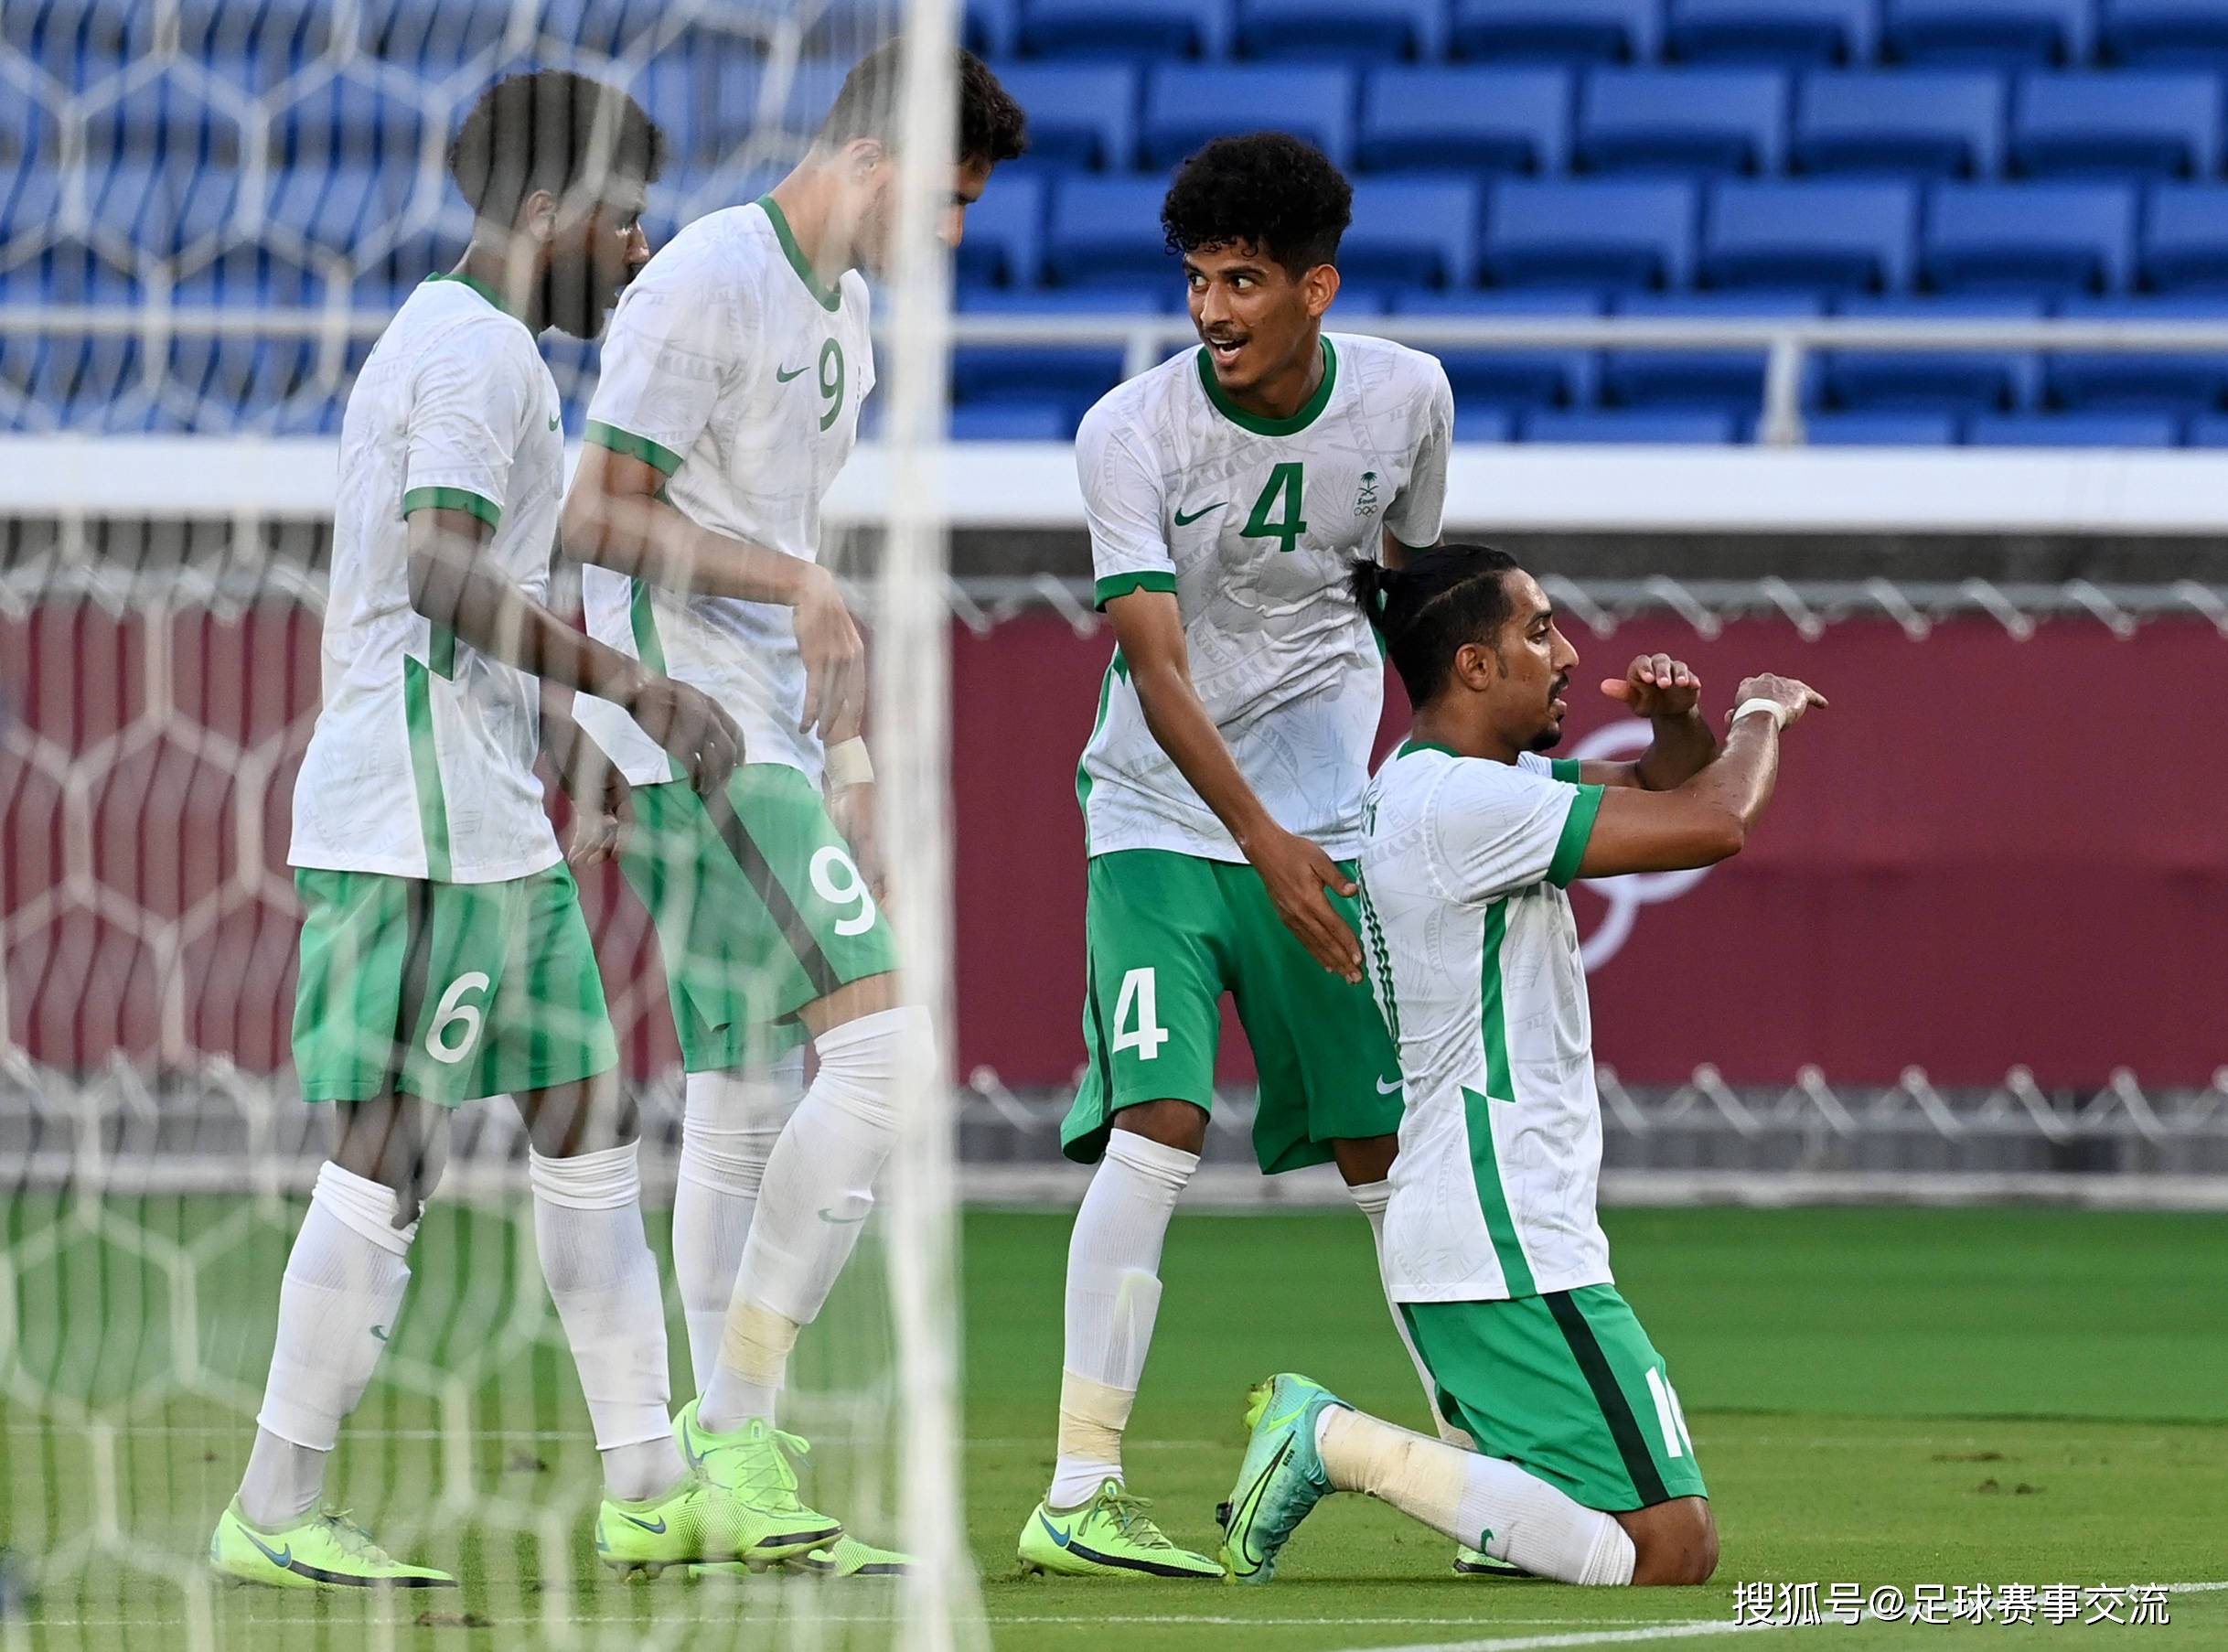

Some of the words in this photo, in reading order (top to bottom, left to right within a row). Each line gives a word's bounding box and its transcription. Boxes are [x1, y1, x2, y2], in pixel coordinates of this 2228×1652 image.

[819, 338, 844, 432] 9
[1239, 462, 1307, 552] 4
[809, 845, 876, 936] 9
[425, 971, 489, 1064] 6
[1112, 967, 1169, 1061] 4
